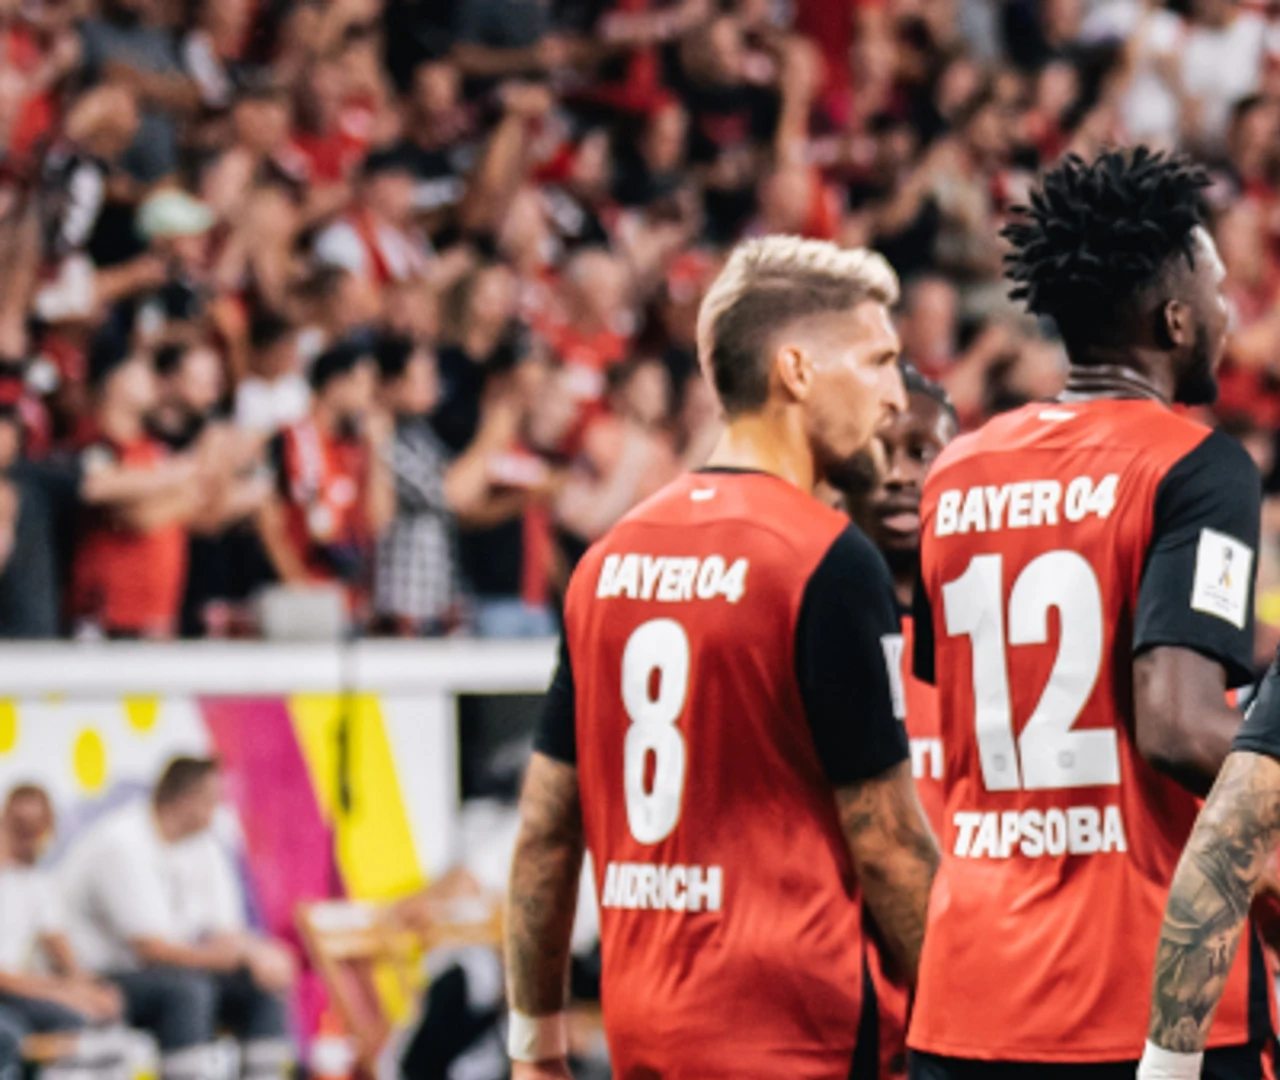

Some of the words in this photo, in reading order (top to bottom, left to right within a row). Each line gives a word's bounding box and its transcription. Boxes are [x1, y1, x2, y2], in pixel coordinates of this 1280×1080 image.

[935, 480, 1061, 537] BAYER
[1065, 473, 1119, 522] 04
[597, 553, 699, 602] BAYER
[697, 554, 748, 604] 04
[942, 550, 1121, 791] 12
[621, 618, 690, 845] 8
[953, 805, 1127, 858] TAPSOBA
[601, 861, 722, 912] ADRICH
